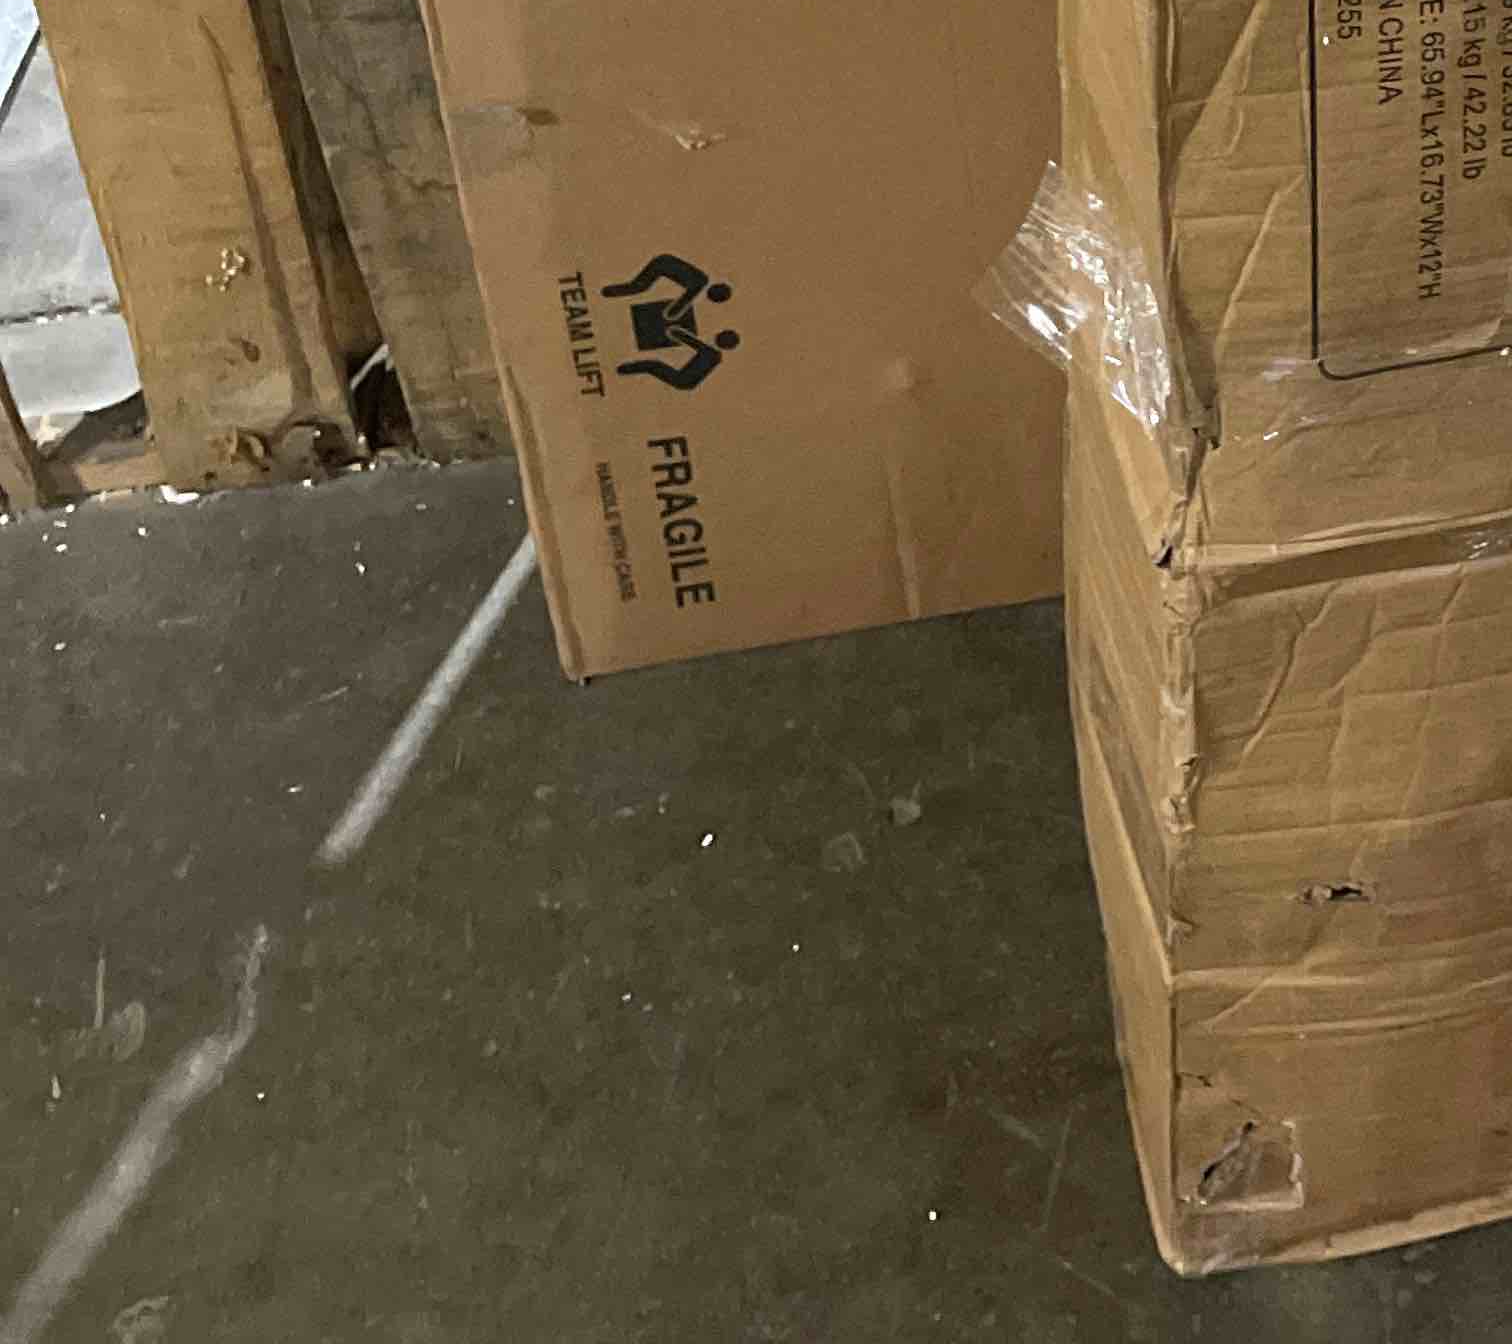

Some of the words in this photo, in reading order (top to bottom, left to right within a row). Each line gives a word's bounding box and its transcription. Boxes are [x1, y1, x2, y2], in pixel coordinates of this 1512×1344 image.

[1377, 16, 1403, 105] CHINA
[1456, 39, 1486, 70] kg
[1460, 85, 1486, 154] 42.22
[1461, 158, 1485, 180] lb
[557, 272, 595, 342] TEAM
[572, 344, 605, 399] LIFT
[647, 435, 716, 608] FRAGILE
